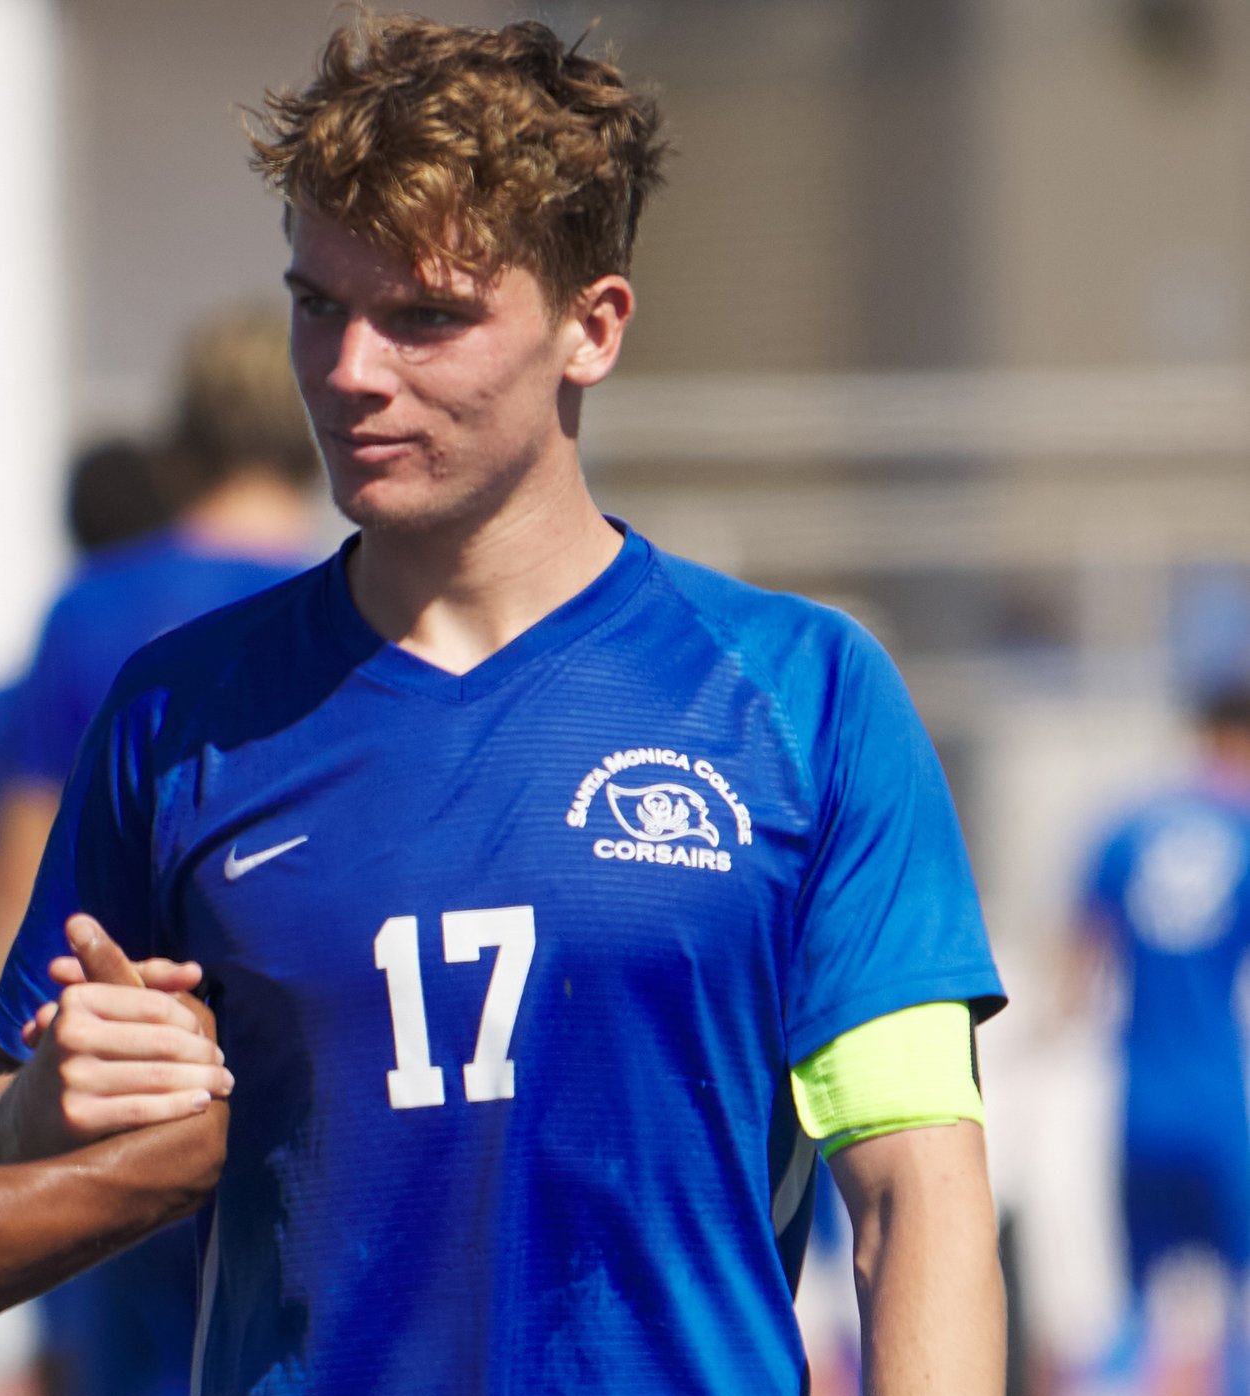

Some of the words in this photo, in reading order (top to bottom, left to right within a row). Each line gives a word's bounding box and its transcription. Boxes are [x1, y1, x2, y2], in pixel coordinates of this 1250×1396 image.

[566, 767, 611, 828] SANTA
[602, 748, 690, 774] MONICA
[593, 838, 732, 872] CORSAIRS
[374, 905, 536, 1109] 17
